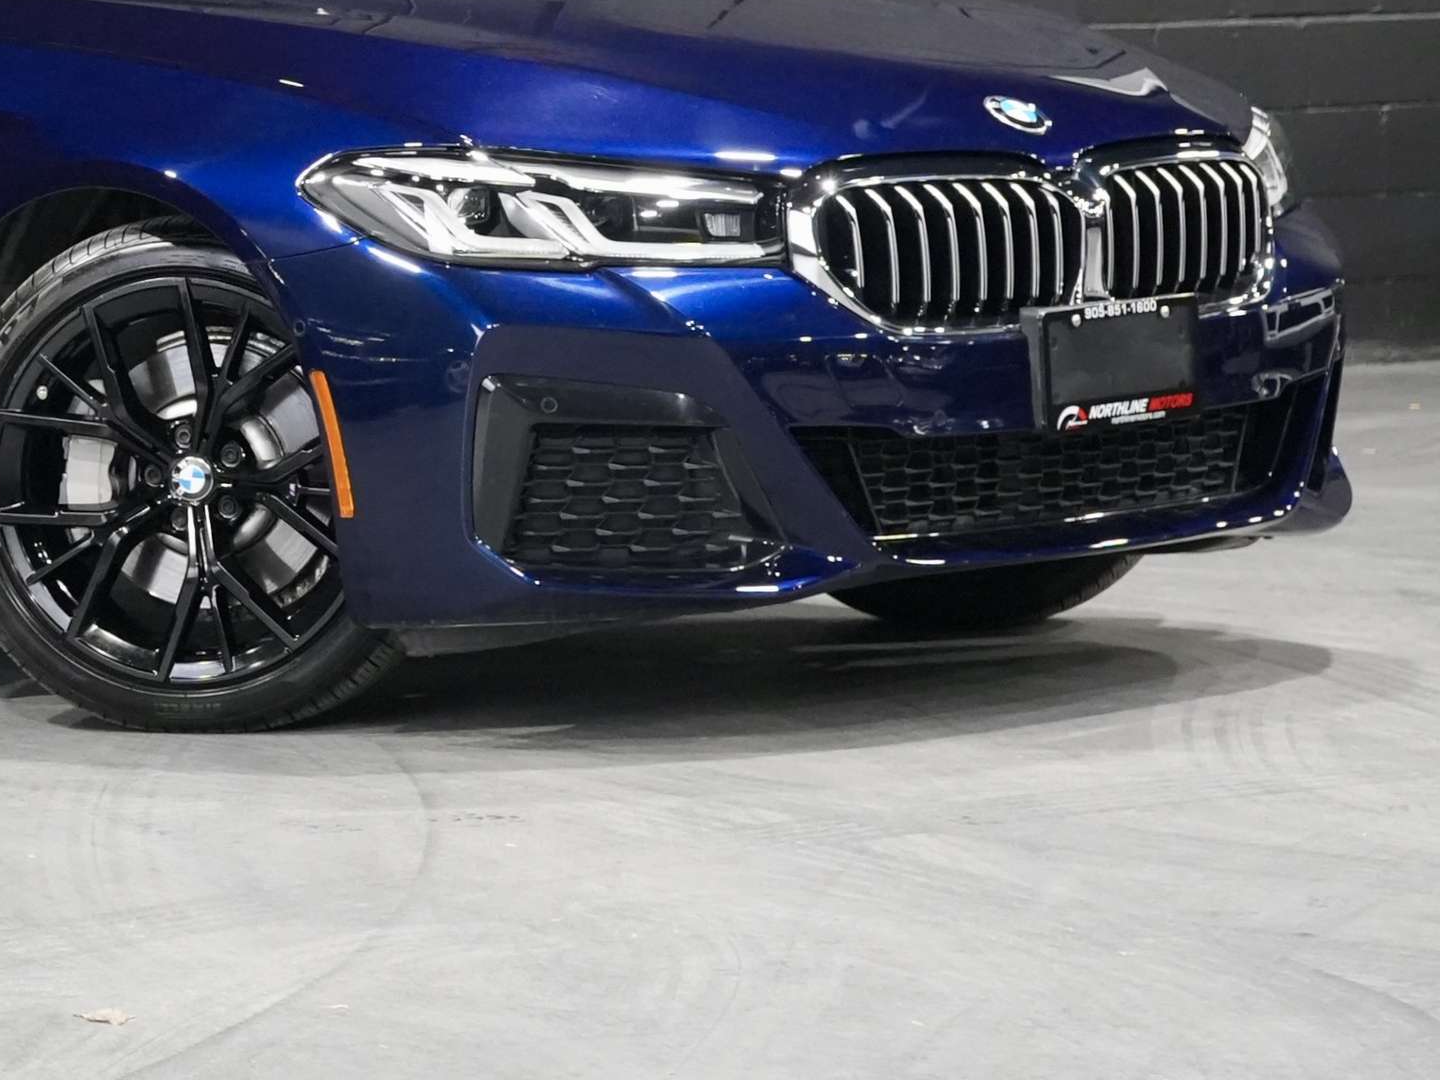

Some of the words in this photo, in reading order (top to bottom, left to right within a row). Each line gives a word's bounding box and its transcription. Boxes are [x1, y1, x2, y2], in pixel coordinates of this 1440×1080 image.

[1083, 300, 1158, 320] 905-851-1600
[1088, 398, 1150, 420] NORTHLINE
[1147, 392, 1194, 411] MOTORS
